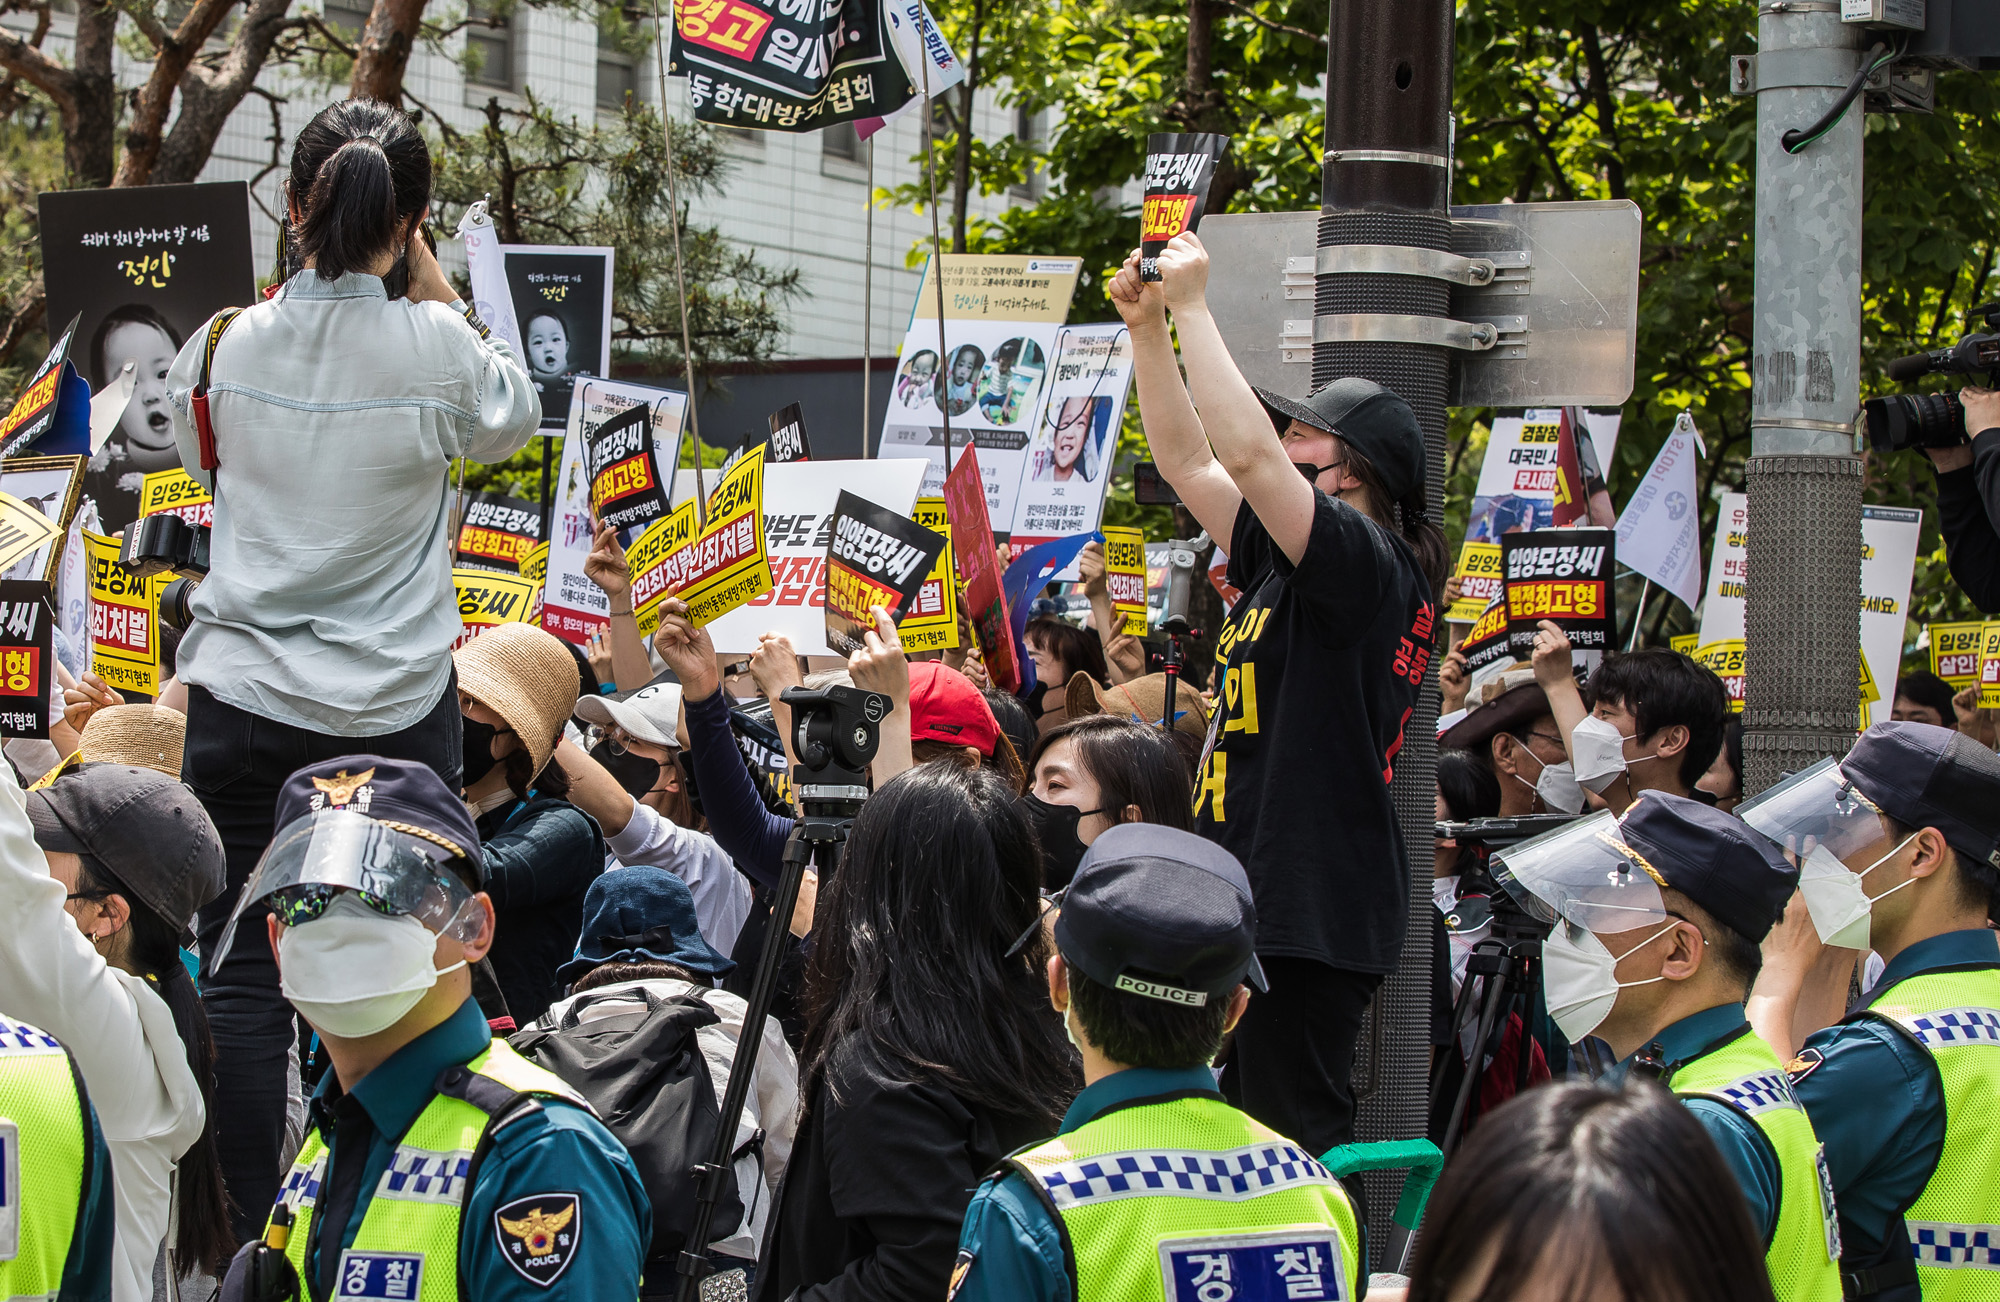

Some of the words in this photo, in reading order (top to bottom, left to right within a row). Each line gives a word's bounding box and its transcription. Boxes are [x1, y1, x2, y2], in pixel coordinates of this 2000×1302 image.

[191, 224, 210, 243] 이름
[1508, 448, 1546, 466] 대국민
[466, 501, 541, 538] 입양모장씨
[831, 513, 928, 586] 입양모장씨
[1108, 541, 1143, 568] 입양모장씨
[1507, 545, 1606, 580] 입양모장씨
[1508, 582, 1598, 617] 법정최고형
[1120, 977, 1198, 1004] POLICE
[511, 1241, 522, 1255] 경
[558, 1233, 570, 1247] 찰
[525, 1253, 561, 1269] POLICE
[1186, 1252, 1234, 1302] 경
[1273, 1245, 1326, 1300] 찰
